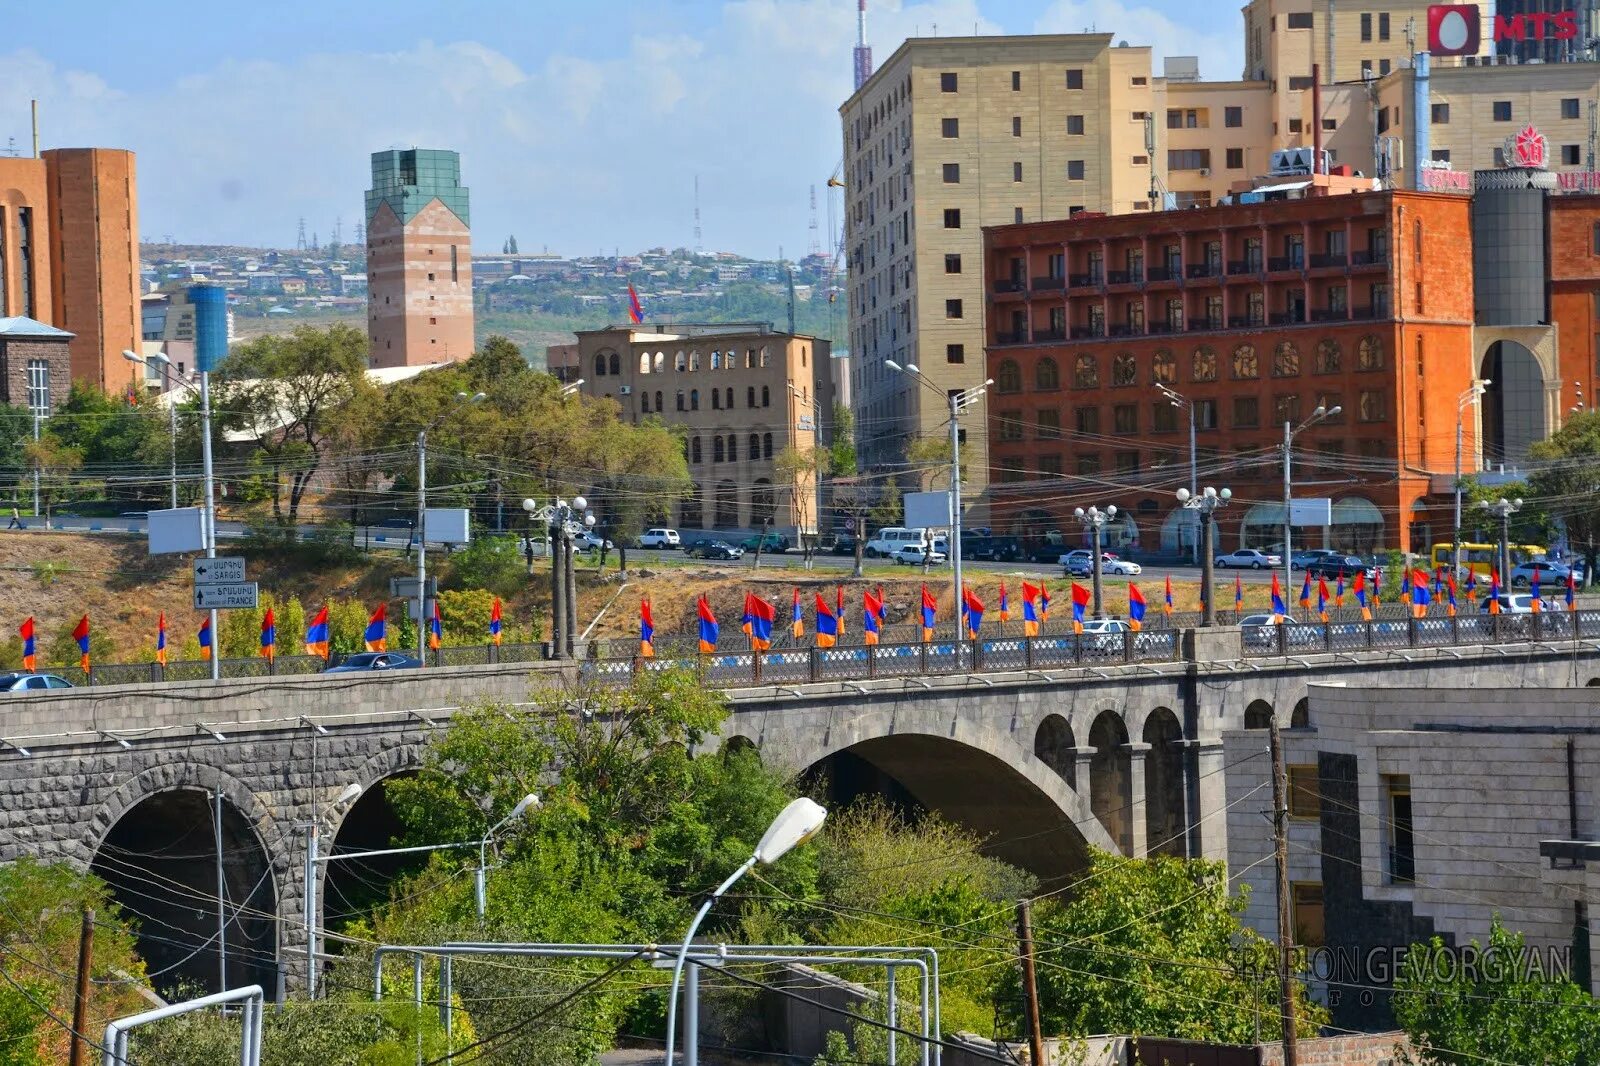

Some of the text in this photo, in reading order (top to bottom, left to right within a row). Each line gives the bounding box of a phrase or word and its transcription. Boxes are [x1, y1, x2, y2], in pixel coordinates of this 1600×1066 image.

[1494, 10, 1578, 42] MTS
[214, 571, 241, 580] SARGIS
[227, 596, 253, 605] FRANCE
